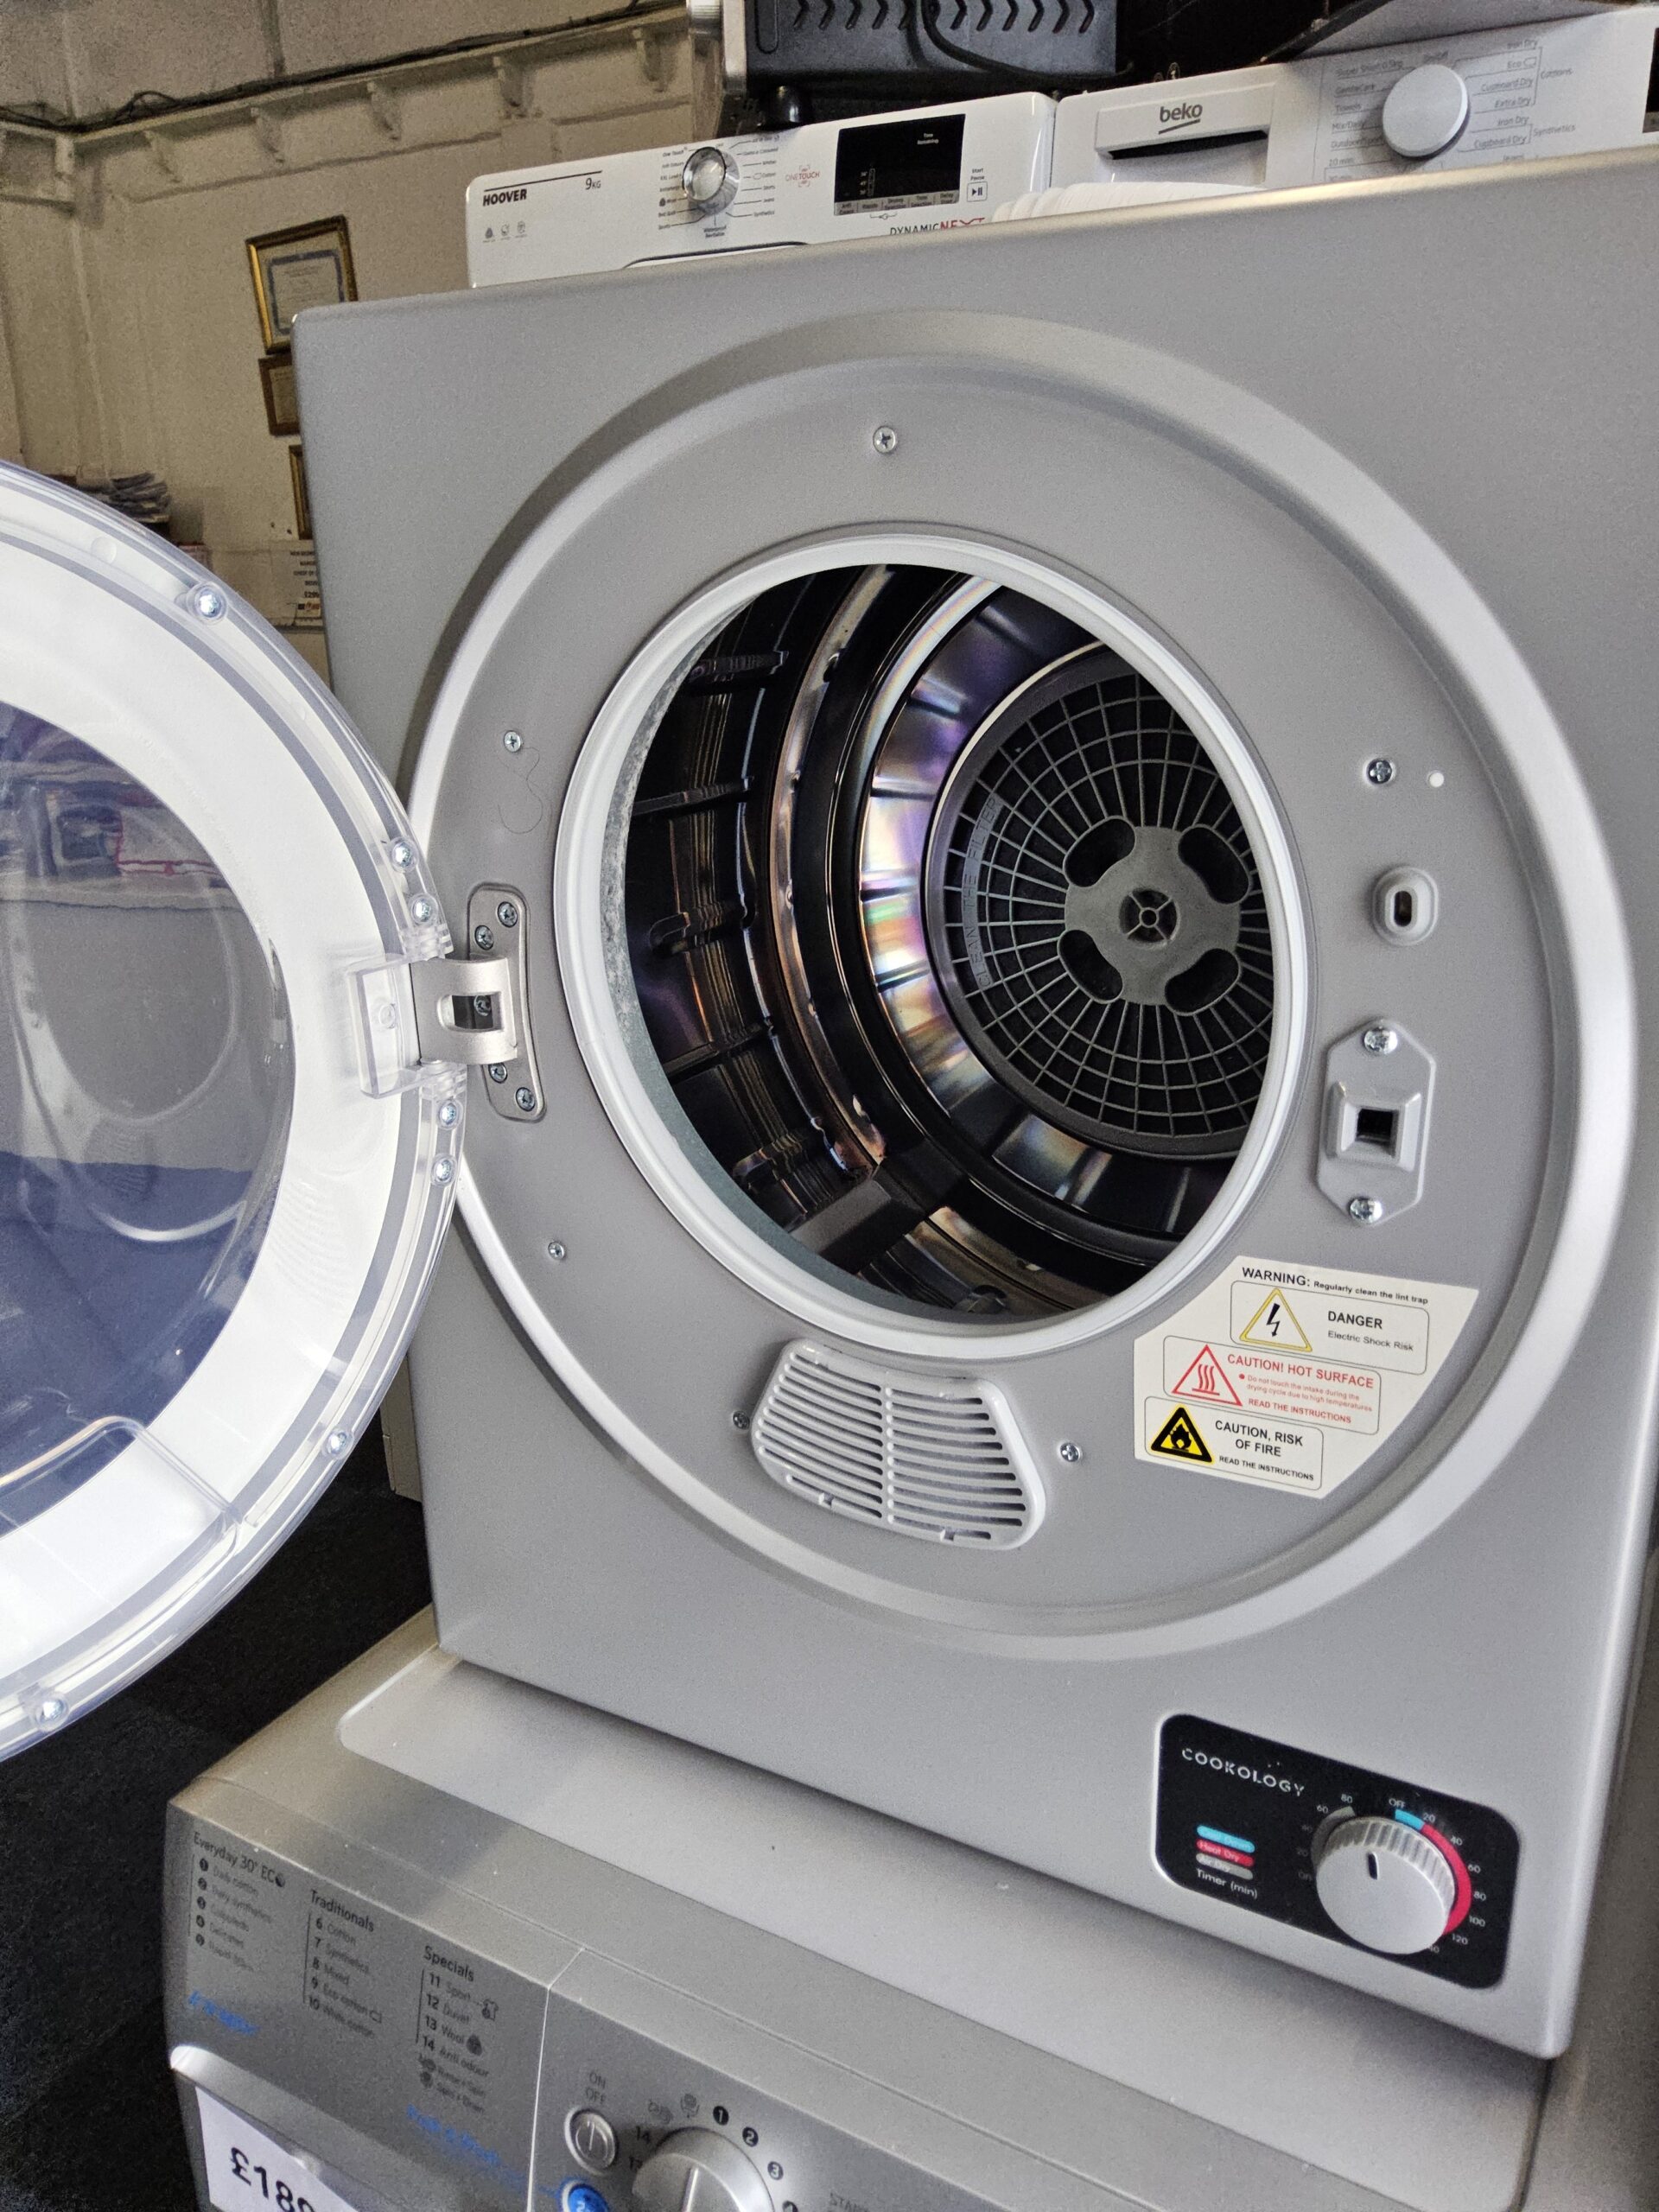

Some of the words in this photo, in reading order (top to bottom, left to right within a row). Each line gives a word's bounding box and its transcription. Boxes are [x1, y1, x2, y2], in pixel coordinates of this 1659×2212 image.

[1160, 103, 1203, 123] beko
[483, 188, 527, 207] HOOVER
[968, 796, 999, 860] FILTER
[963, 874, 977, 907] THE
[965, 925, 992, 988] CLEAN
[1243, 1267, 1310, 1287] WARNING:
[1314, 1281, 1352, 1294] Regularly
[1355, 1287, 1377, 1297] clean
[1395, 1293, 1408, 1301] lint
[1412, 1295, 1428, 1305] trap
[1328, 1311, 1382, 1329] DANGER
[1328, 1330, 1362, 1344] Electric
[1363, 1335, 1390, 1348] Shock
[1394, 1340, 1414, 1351] Risk
[1227, 1353, 1284, 1372] CAUTION!
[1287, 1363, 1313, 1377] HOT
[1316, 1369, 1374, 1389] SURFACE
[1246, 1384, 1267, 1395] drying
[1268, 1388, 1286, 1397] cycle
[1287, 1390, 1300, 1399] due
[1310, 1394, 1325, 1403] high
[1270, 1379, 1289, 1389] touch
[1290, 1382, 1301, 1390] the
[1303, 1384, 1324, 1395] intake
[1325, 1389, 1346, 1400] during
[1348, 1392, 1359, 1401] the
[1249, 1398, 1270, 1408] READ
[1273, 1402, 1288, 1413] THE
[1291, 1405, 1351, 1424] INSTRUCTIONS
[1215, 1421, 1271, 1441] CAUTION,
[1274, 1432, 1303, 1446] RISK
[1236, 1439, 1250, 1450] OF
[1255, 1442, 1281, 1457] FIRE
[1219, 1455, 1239, 1465] READ
[1242, 1459, 1256, 1469] THE
[1258, 1463, 1313, 1481] INSTRUCTIONS
[1182, 1748, 1304, 1796] COOKOLOGY
[1341, 1794, 1352, 1803] 80
[1389, 1798, 1406, 1808] OFF
[1317, 1804, 1328, 1814] 60
[1423, 1813, 1436, 1822] 20
[194, 1831, 238, 1866] Everyday
[1450, 1835, 1463, 1846] 40
[1468, 1865, 1481, 1873] 60
[1196, 1867, 1226, 1886] Timer
[1230, 1880, 1257, 1900] (min)
[1473, 1891, 1486, 1901] 80
[311, 1889, 374, 1933] Traditionals
[316, 1917, 322, 1929] 6
[1470, 1916, 1485, 1927] 100
[315, 1936, 321, 1948] 7
[1452, 1934, 1468, 1944] 120
[313, 1956, 320, 1970] 8
[423, 1945, 474, 1982] Specials
[311, 1976, 318, 1989] 9
[429, 1973, 440, 1987] 11
[309, 1995, 320, 2010] 10
[427, 1993, 439, 2011] 12
[425, 2015, 437, 2031] 13
[423, 2036, 435, 2051] 14
